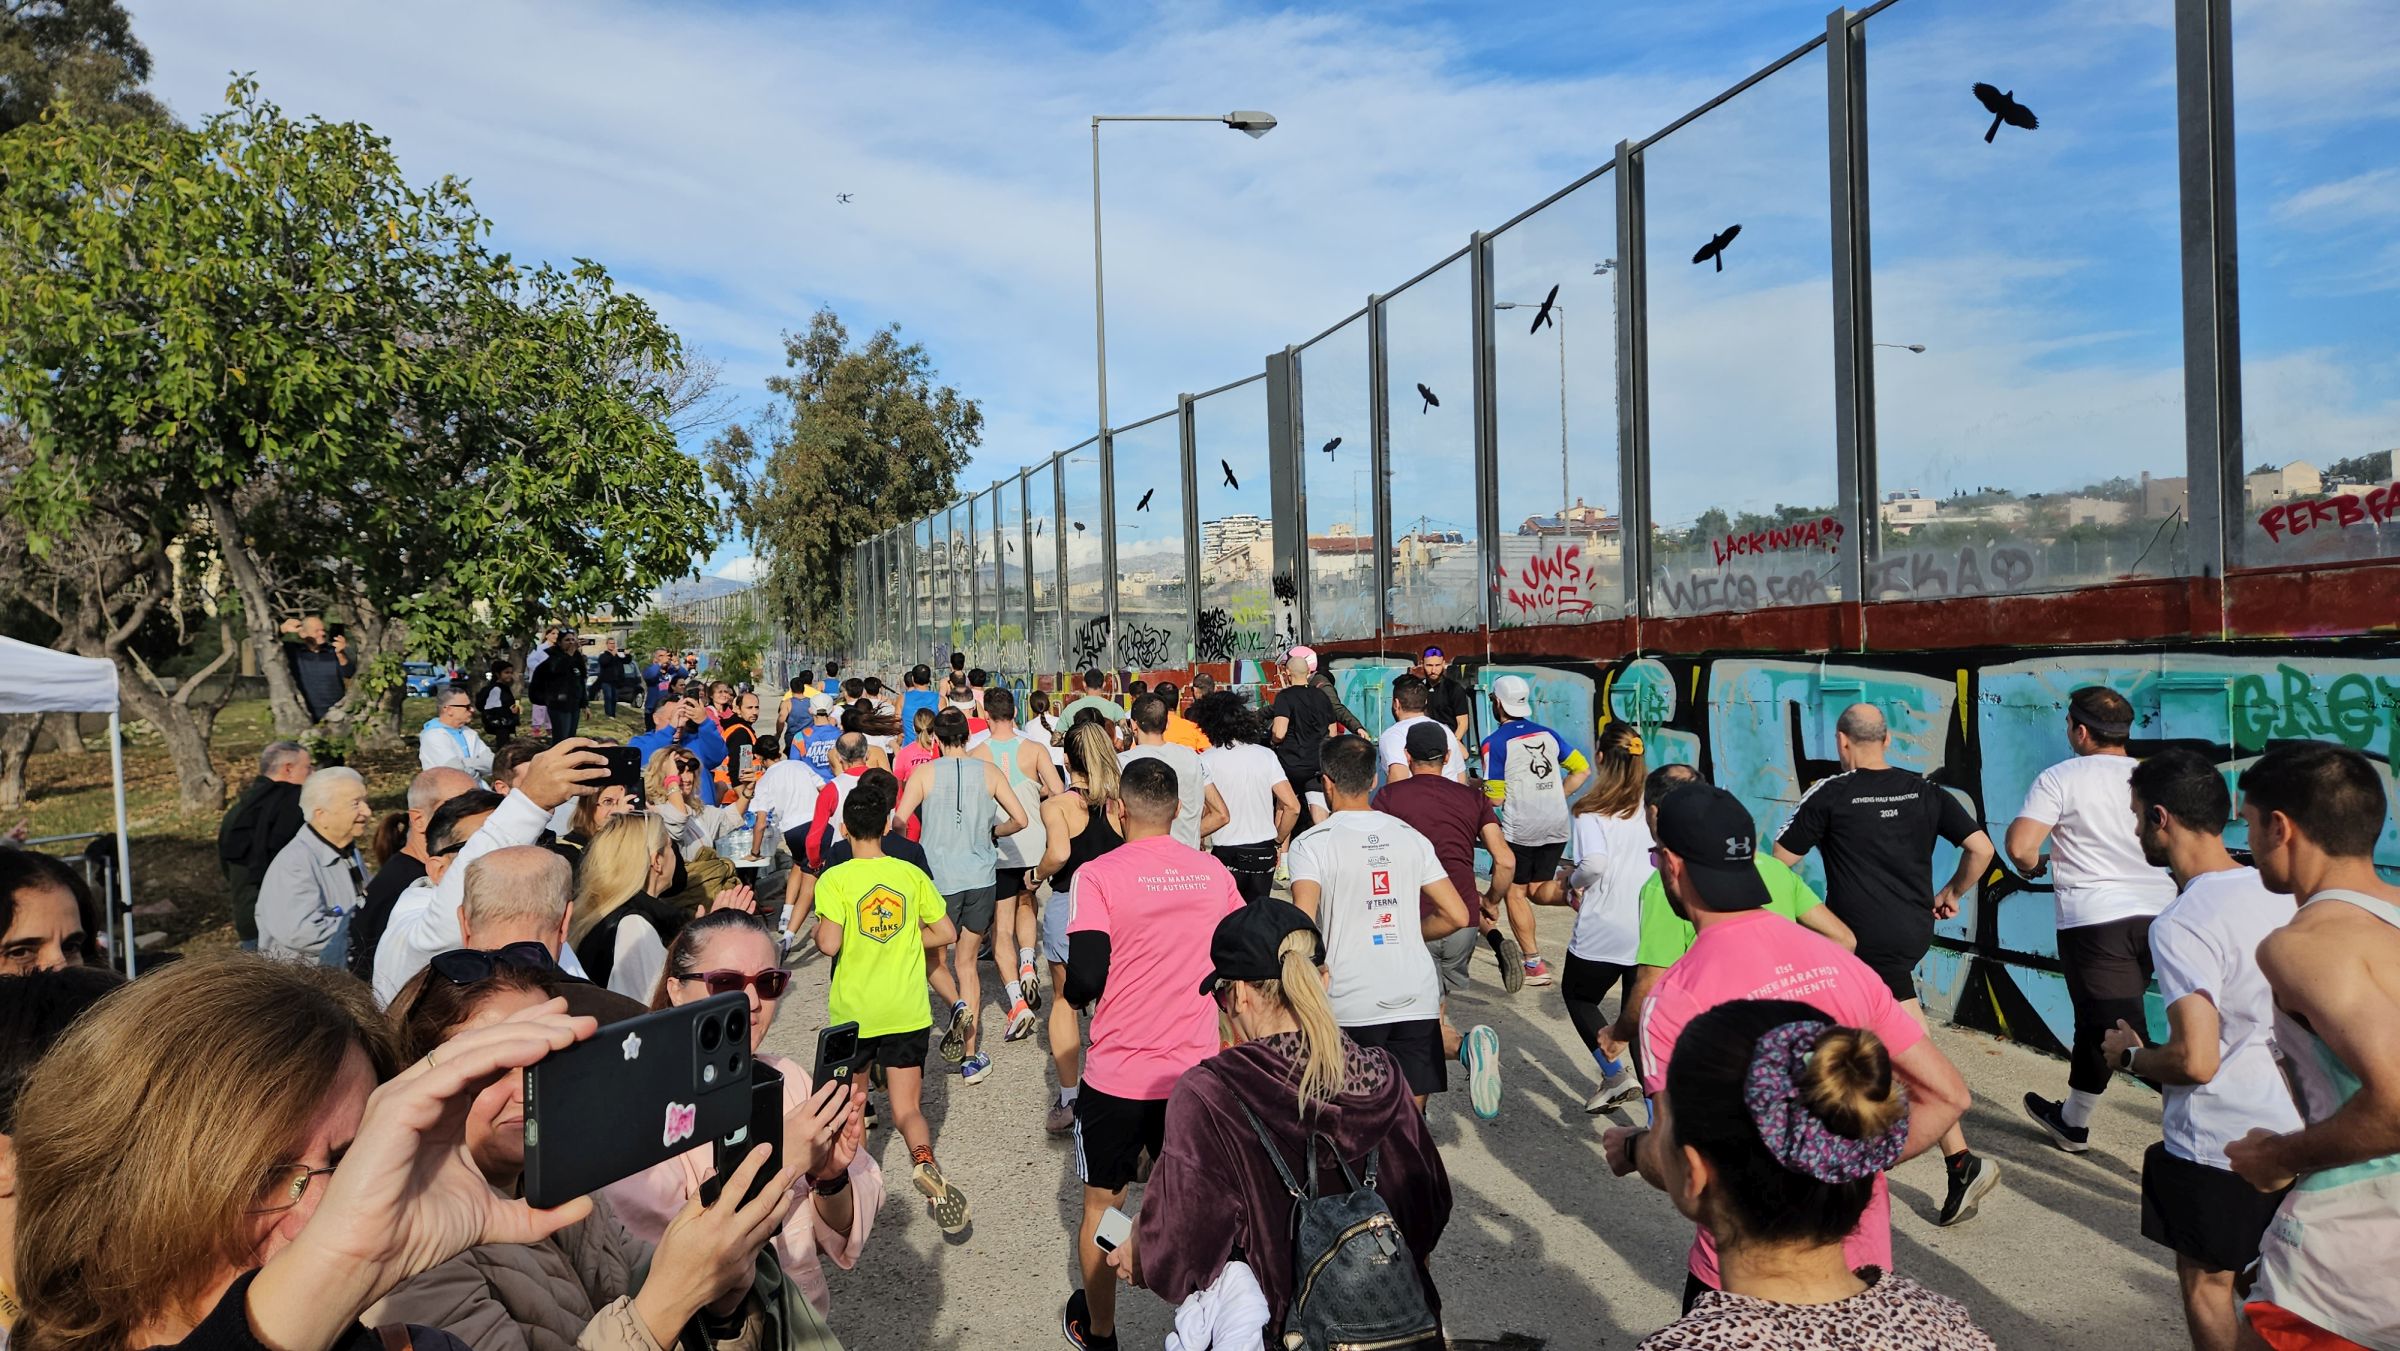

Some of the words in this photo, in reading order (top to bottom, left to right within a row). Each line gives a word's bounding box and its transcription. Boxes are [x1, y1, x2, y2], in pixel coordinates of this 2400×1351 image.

[1889, 793, 1919, 802] MARATHON
[1880, 809, 1899, 818] 2024
[1168, 874, 1210, 882] MARATHON
[1147, 884, 1160, 892] THE
[1163, 883, 1207, 891] AUTHENTIC
[1373, 898, 1398, 906] TERNA
